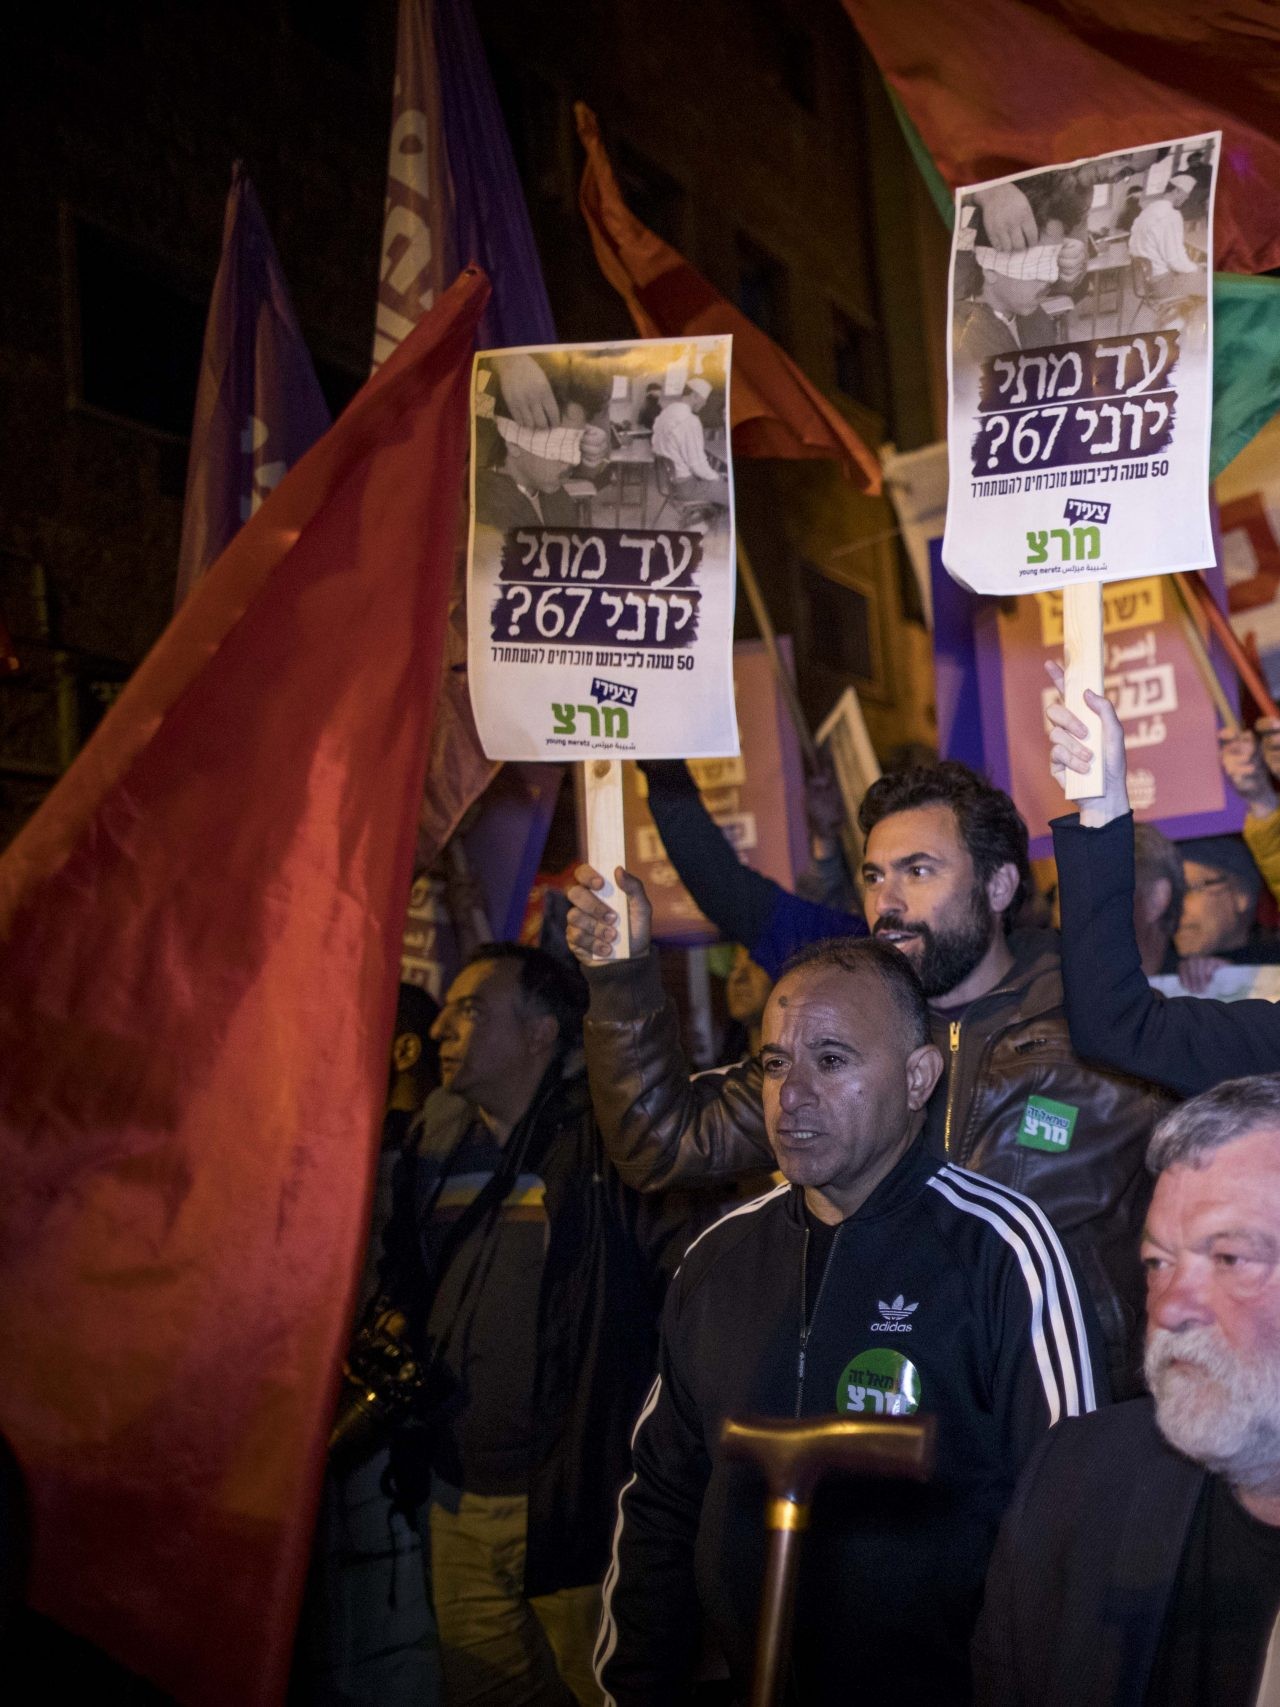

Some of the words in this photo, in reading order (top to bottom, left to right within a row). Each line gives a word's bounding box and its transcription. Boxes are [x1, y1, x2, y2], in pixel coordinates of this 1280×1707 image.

[993, 351, 1083, 404] מתי
[1095, 336, 1169, 397] עד
[1075, 398, 1169, 455] יוני
[985, 406, 1068, 470] 67?
[1070, 464, 1118, 486] לכיבוש
[1120, 462, 1148, 480] שנה
[1151, 460, 1169, 477] 50
[971, 476, 1022, 498] להשתחרר
[1024, 472, 1066, 492] מוכרחים
[1068, 501, 1108, 521] צעירי
[516, 531, 607, 579] מתי
[1026, 526, 1101, 564] מרצ
[619, 534, 693, 590] עד
[1019, 568, 1038, 577] young
[1039, 566, 1061, 574] meretz
[506, 585, 593, 638] 67?
[600, 591, 693, 642] יוני
[490, 646, 545, 664] להשתחרר
[547, 649, 593, 666] מוכרחים
[595, 650, 645, 668] לכיבוש
[646, 652, 674, 670] שנה
[677, 655, 694, 671] 50
[595, 680, 635, 704] צעירי
[551, 703, 629, 739] מרצ
[546, 738, 566, 747] young
[568, 739, 590, 747] meretz
[1024, 1116, 1068, 1146] מרצ
[870, 1321, 913, 1332] adidas
[866, 1369, 895, 1391] מאל
